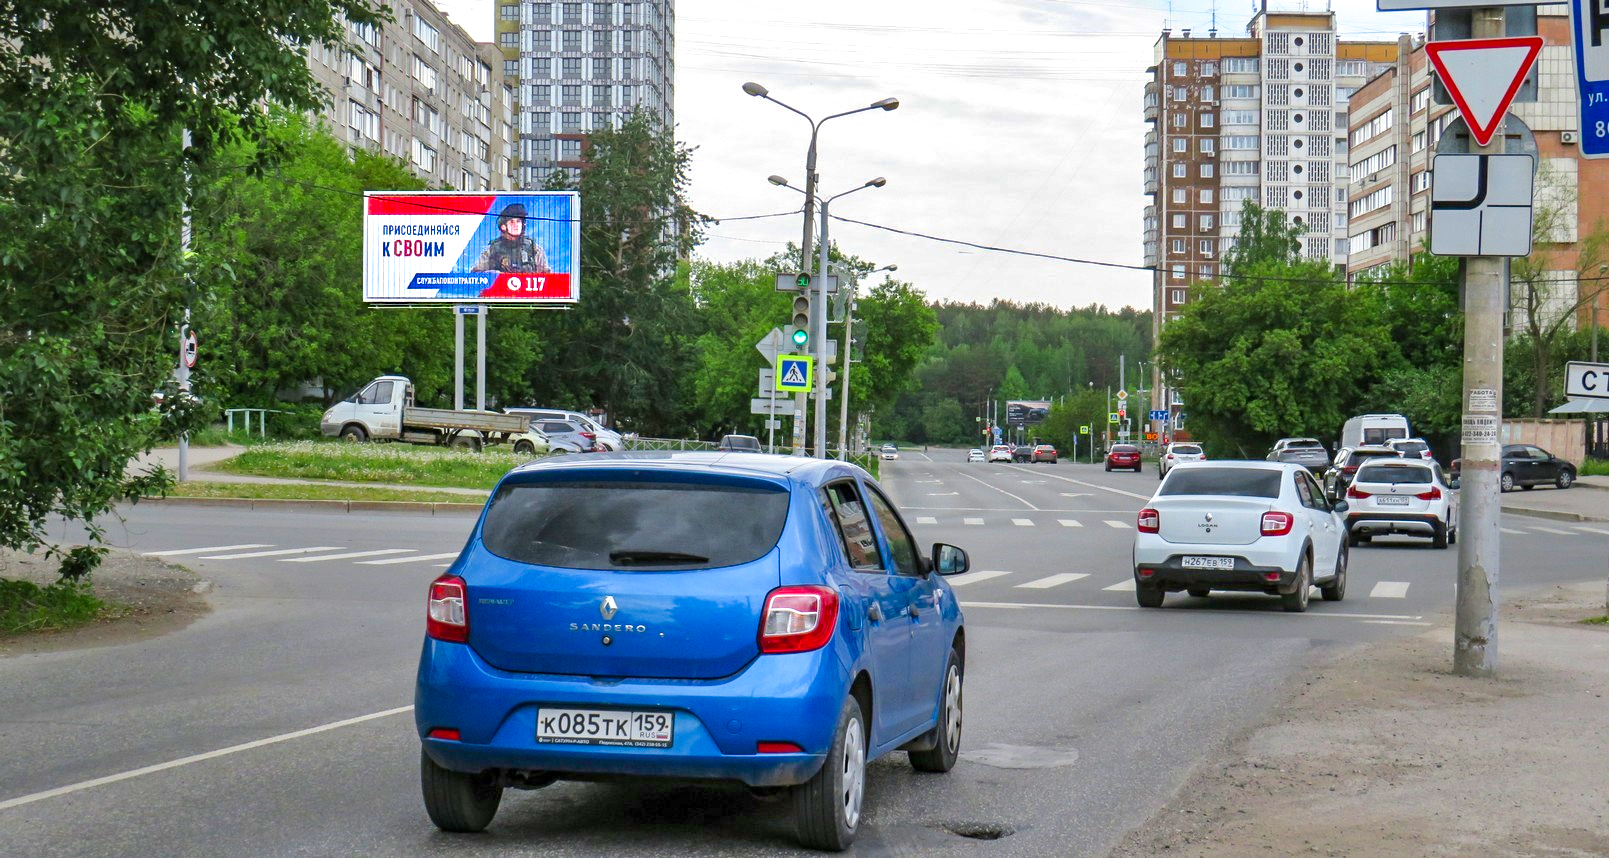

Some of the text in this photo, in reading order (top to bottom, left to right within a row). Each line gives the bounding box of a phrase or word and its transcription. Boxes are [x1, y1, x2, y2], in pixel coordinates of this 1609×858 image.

[383, 223, 460, 236] ПРИСОЕДИНЯЙСЯ
[525, 277, 546, 292] 117
[569, 622, 646, 633] SANDERO
[543, 712, 666, 737] К085ТК 159
[639, 731, 656, 739] RUS
